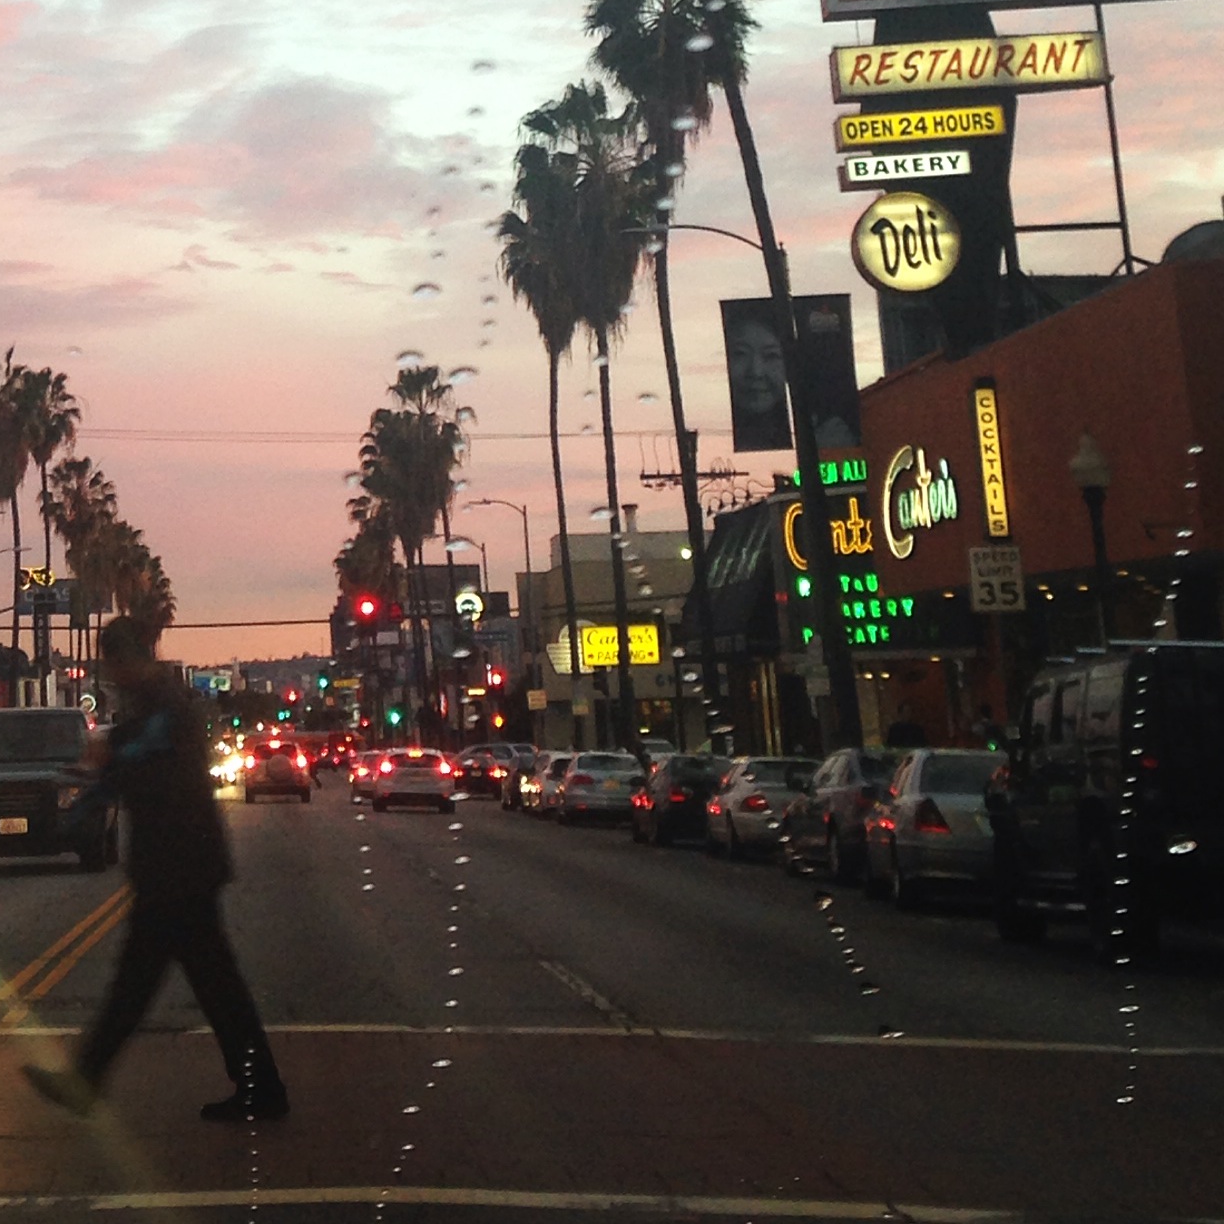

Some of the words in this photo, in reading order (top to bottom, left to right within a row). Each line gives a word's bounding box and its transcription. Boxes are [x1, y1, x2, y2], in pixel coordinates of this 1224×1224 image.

[849, 39, 1093, 87] RESTAURANT
[845, 119, 894, 140] OPEN
[898, 116, 928, 136] 24
[933, 111, 996, 133] HOURS
[854, 154, 962, 177] BAKERY
[870, 205, 944, 278] Deli
[979, 397, 1006, 533] COCKTAILS
[979, 581, 1019, 606] 35
